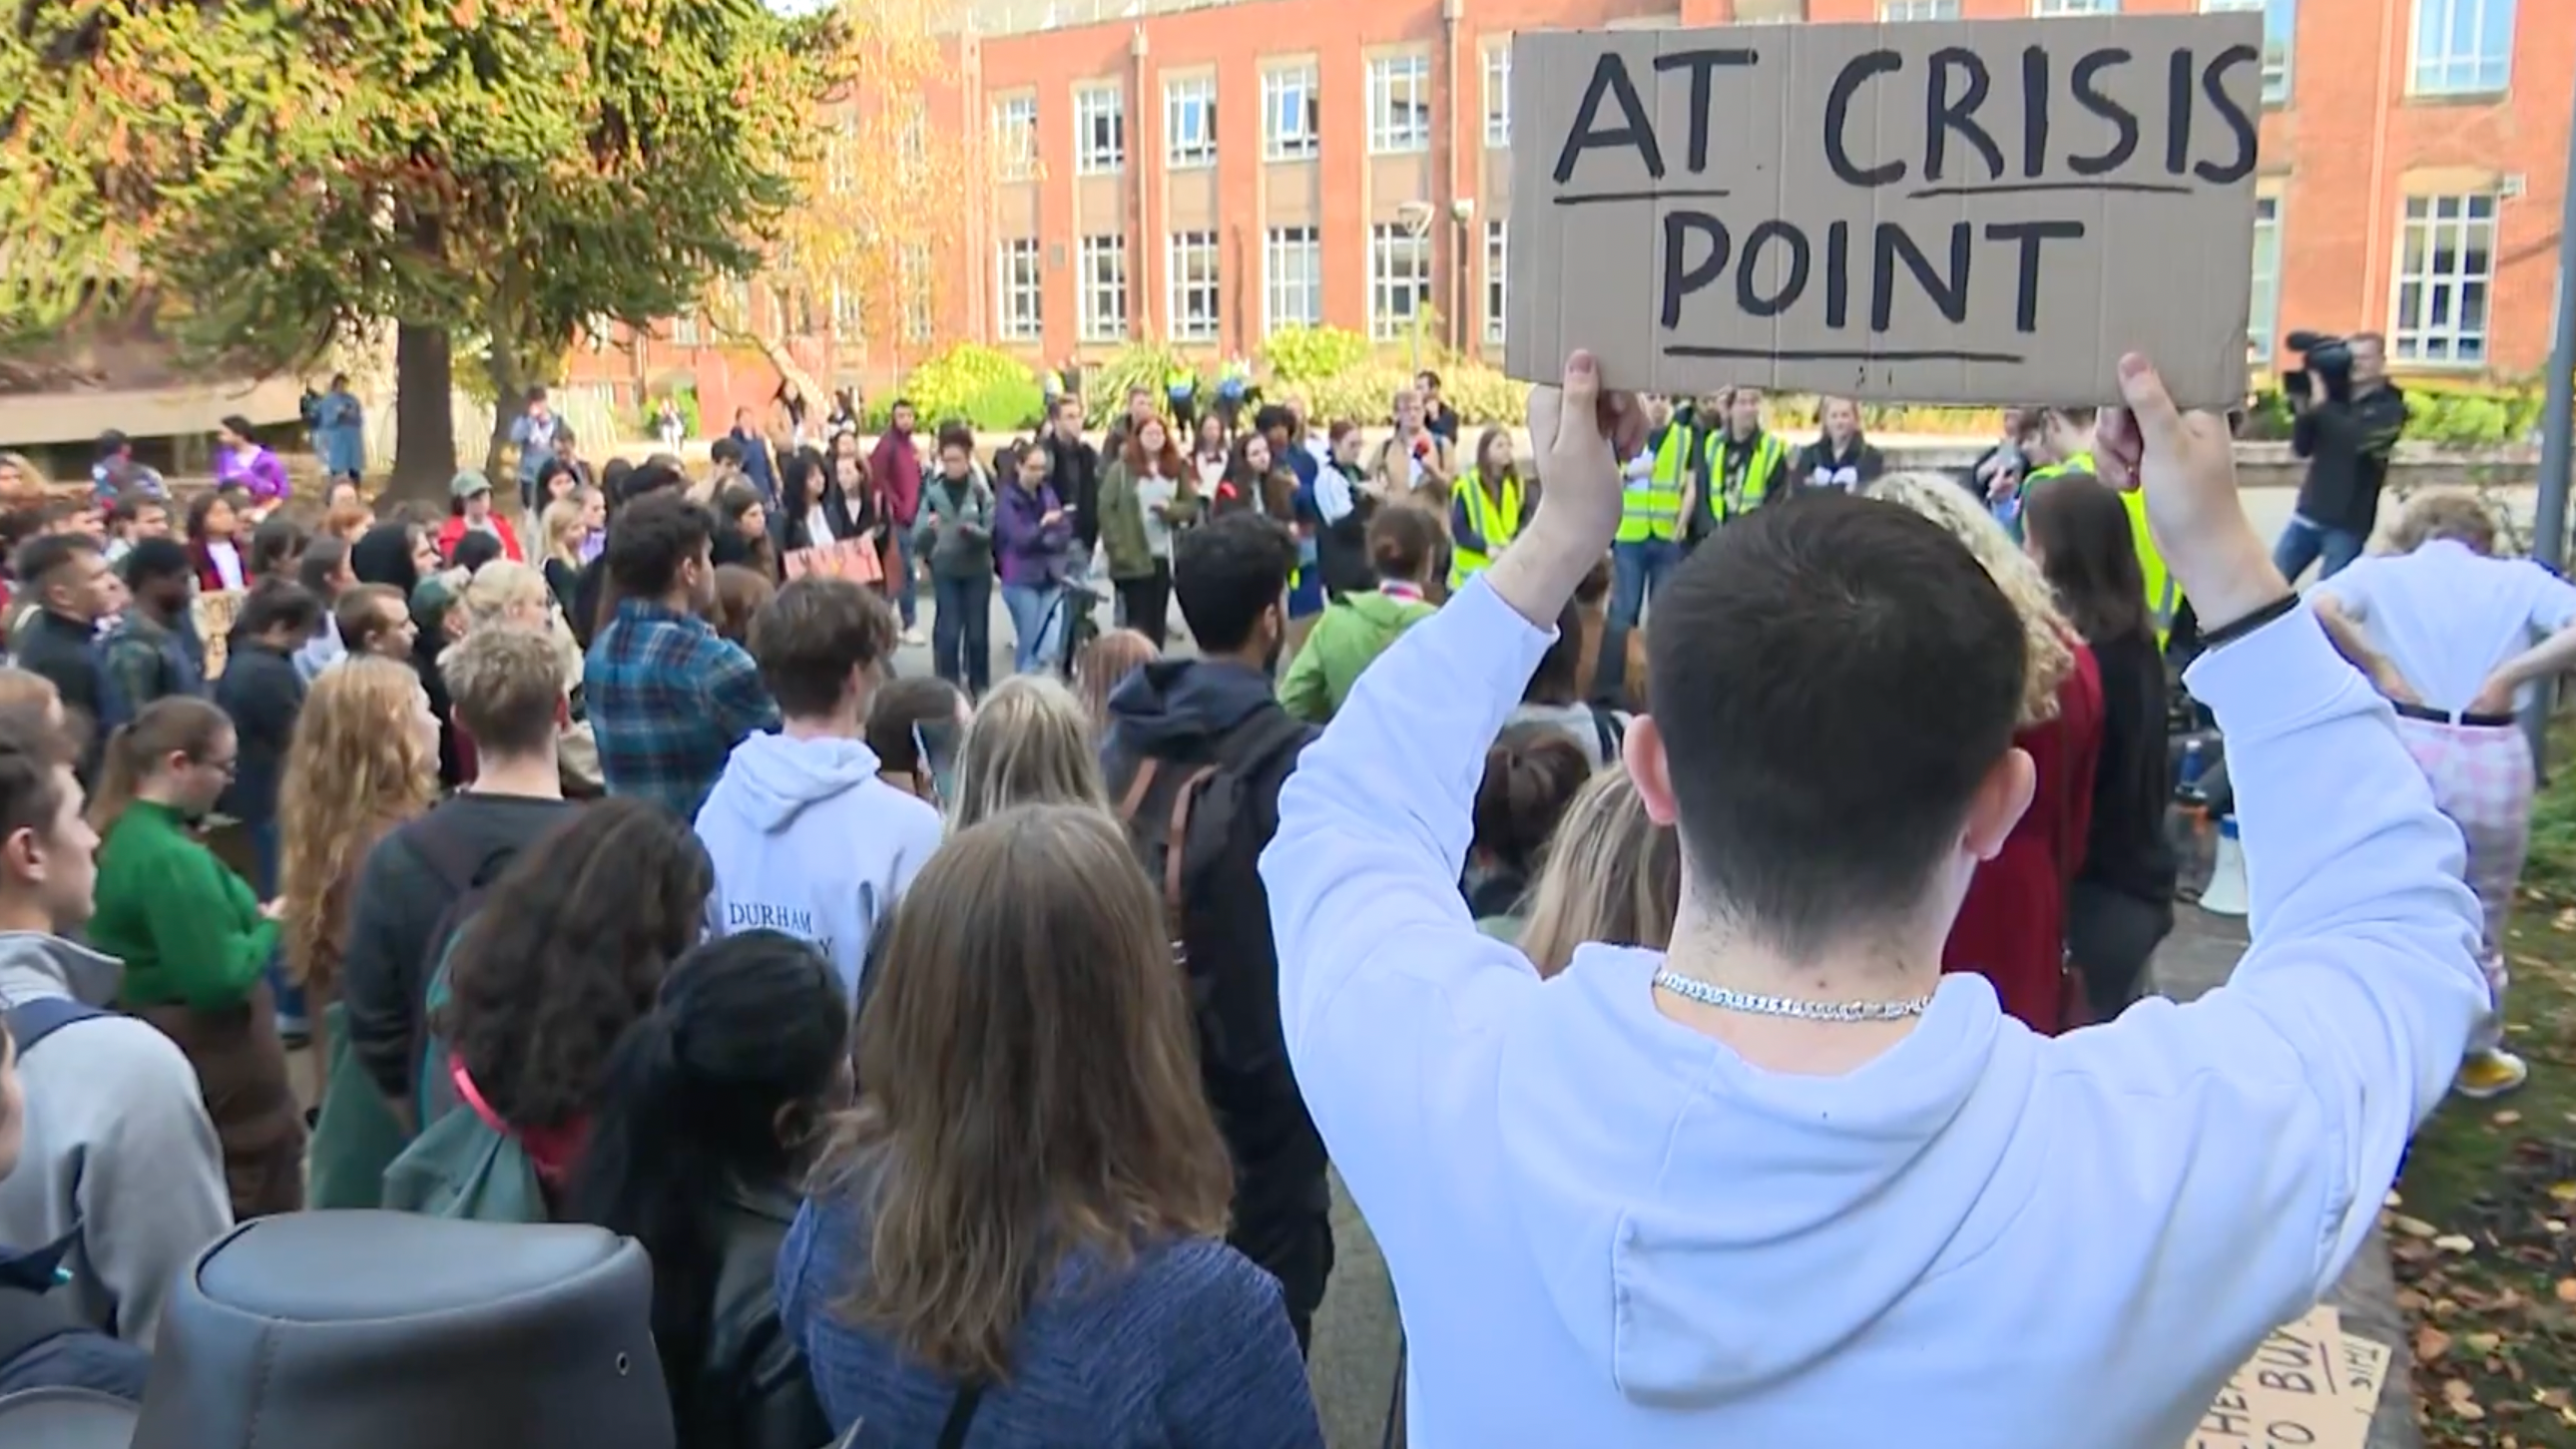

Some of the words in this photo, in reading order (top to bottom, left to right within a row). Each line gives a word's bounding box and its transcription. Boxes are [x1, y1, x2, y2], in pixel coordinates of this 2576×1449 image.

[1554, 48, 1759, 185] AT
[1824, 43, 2260, 188] CRISIS
[1660, 211, 2084, 333] POINT
[729, 901, 812, 934] DURHAM
